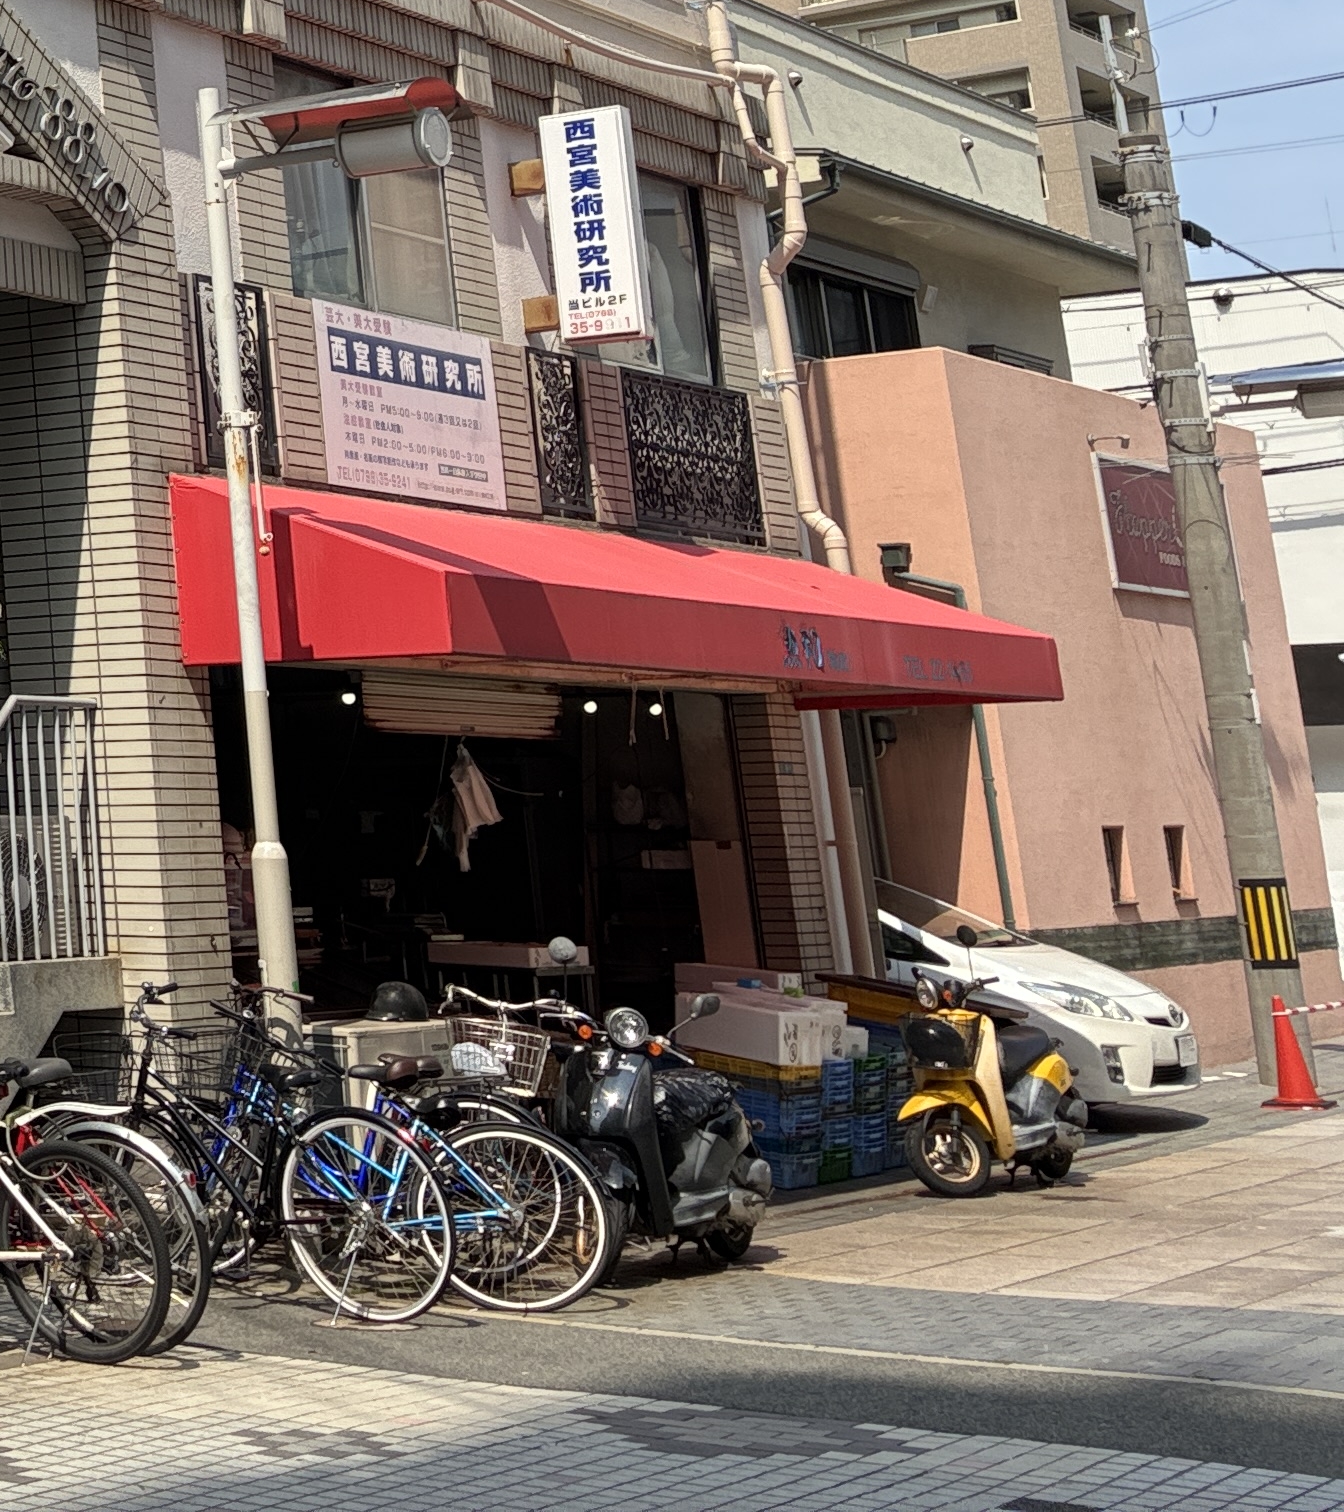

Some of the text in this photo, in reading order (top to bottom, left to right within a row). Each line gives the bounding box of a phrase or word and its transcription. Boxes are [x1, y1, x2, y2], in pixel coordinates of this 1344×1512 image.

[563, 117, 612, 294] 西宮美術研究所
[330, 335, 484, 395] 西宮美術研究所
